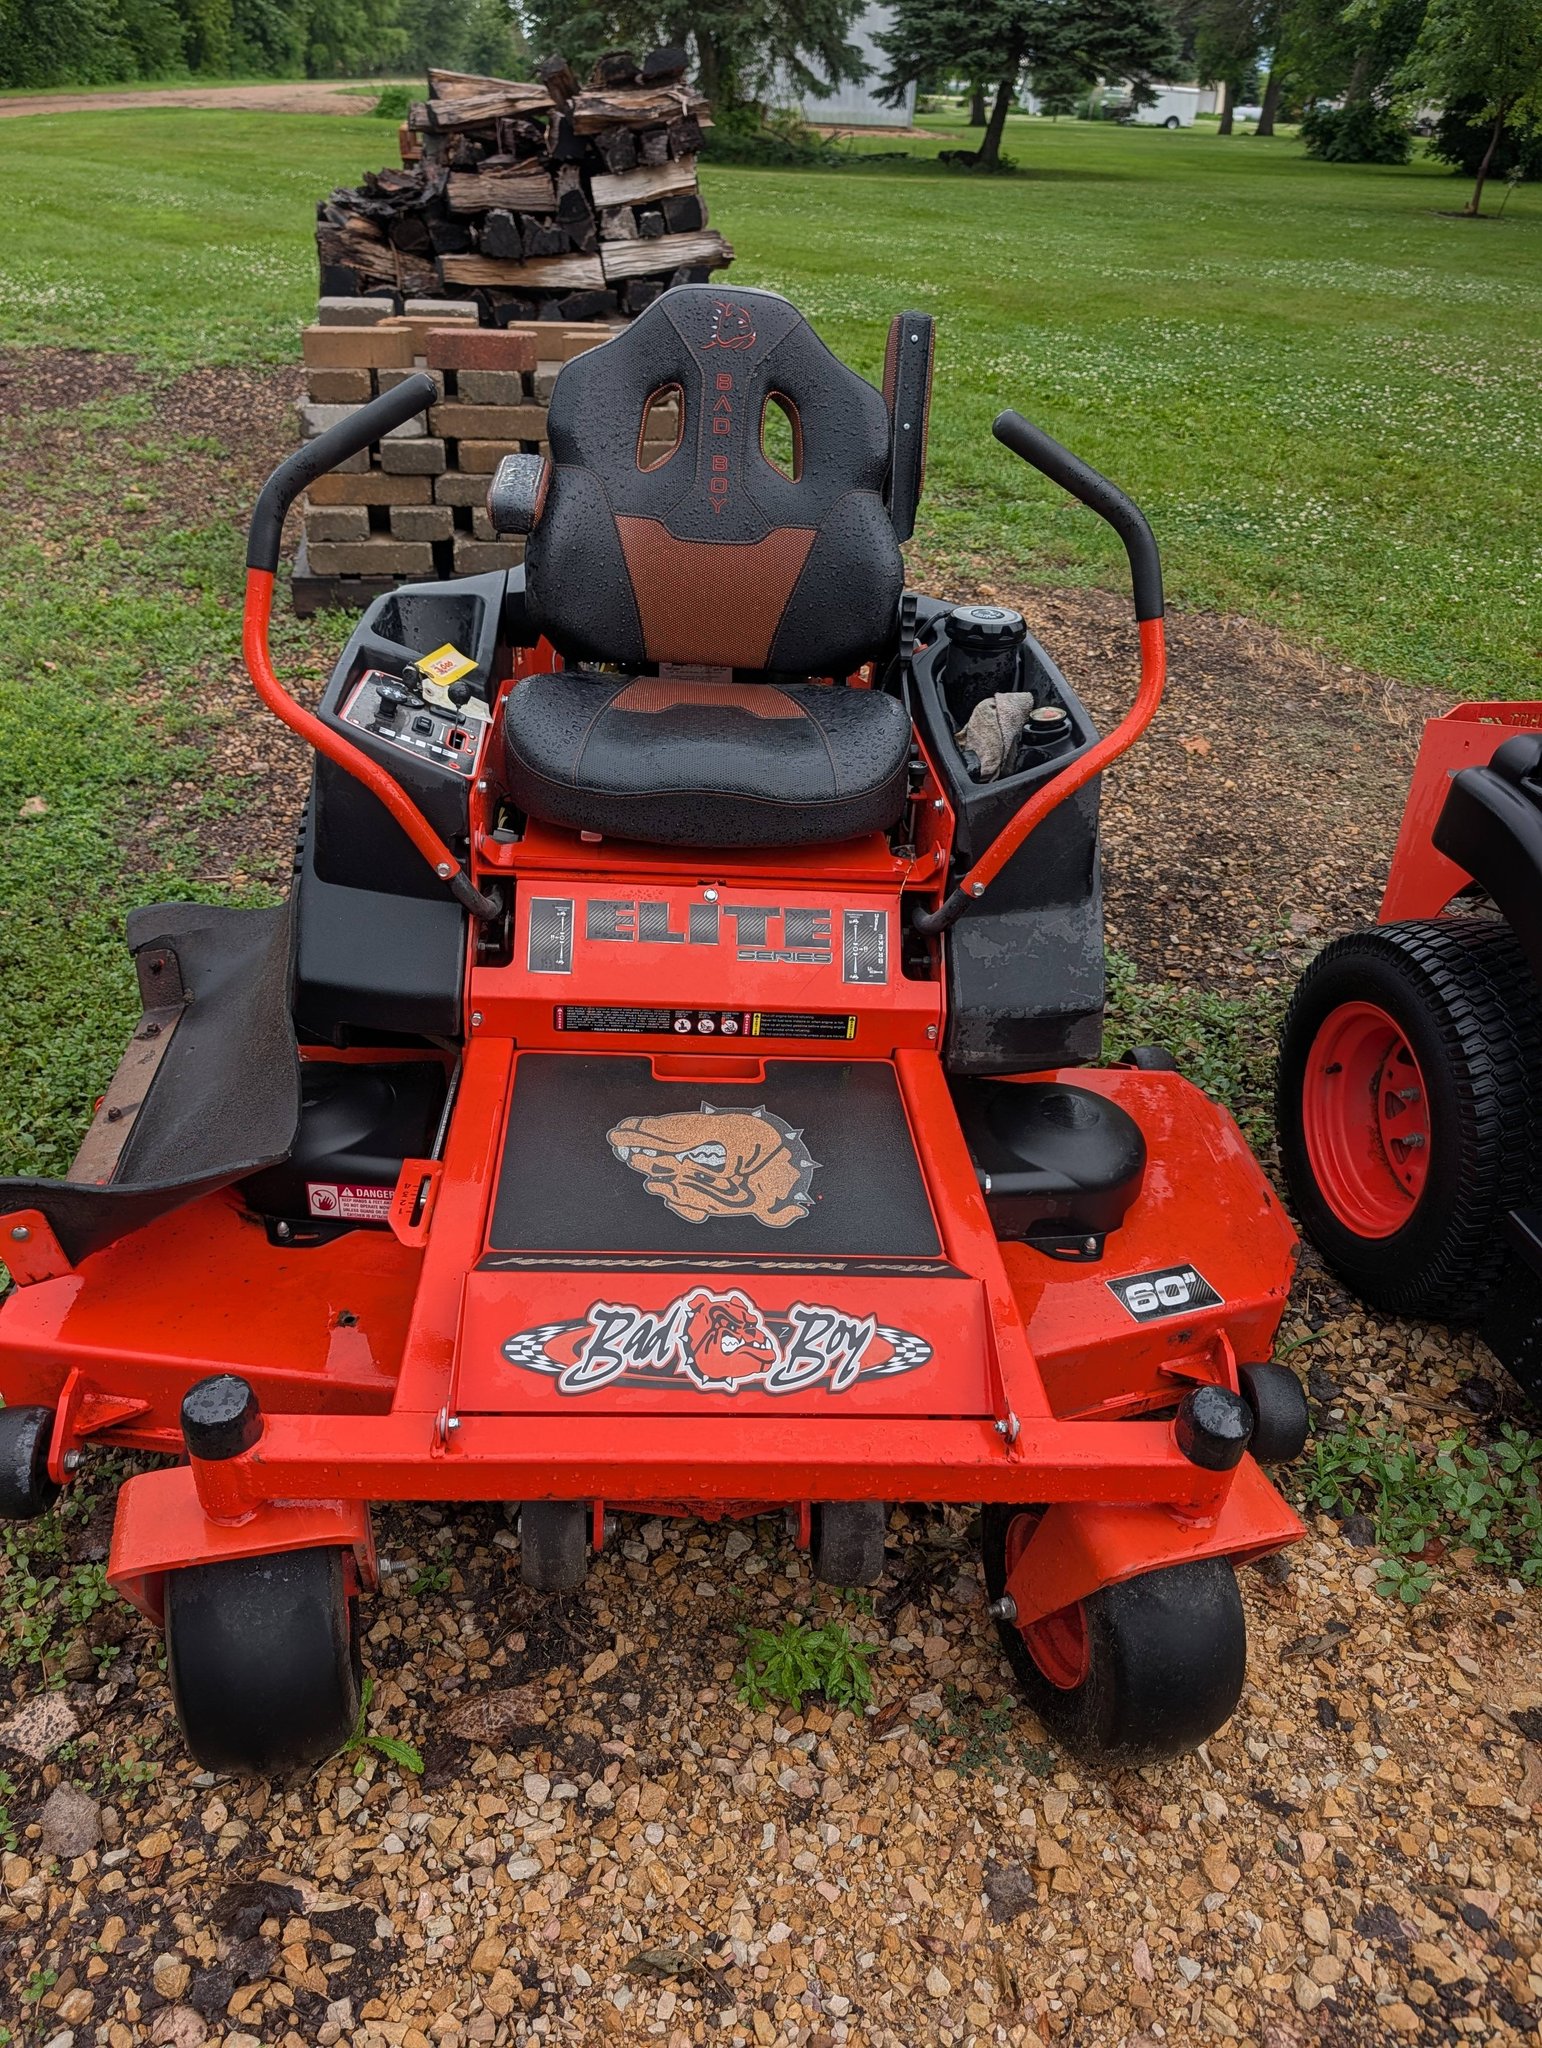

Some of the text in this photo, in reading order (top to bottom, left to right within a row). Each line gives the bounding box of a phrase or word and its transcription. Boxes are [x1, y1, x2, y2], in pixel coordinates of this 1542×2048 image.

[709, 373, 732, 514] BAD BOY
[585, 899, 831, 949] ELITE
[736, 949, 832, 964] SERIES
[1126, 1272, 1196, 1312] 60"
[561, 1303, 874, 1389] Bad Boy
